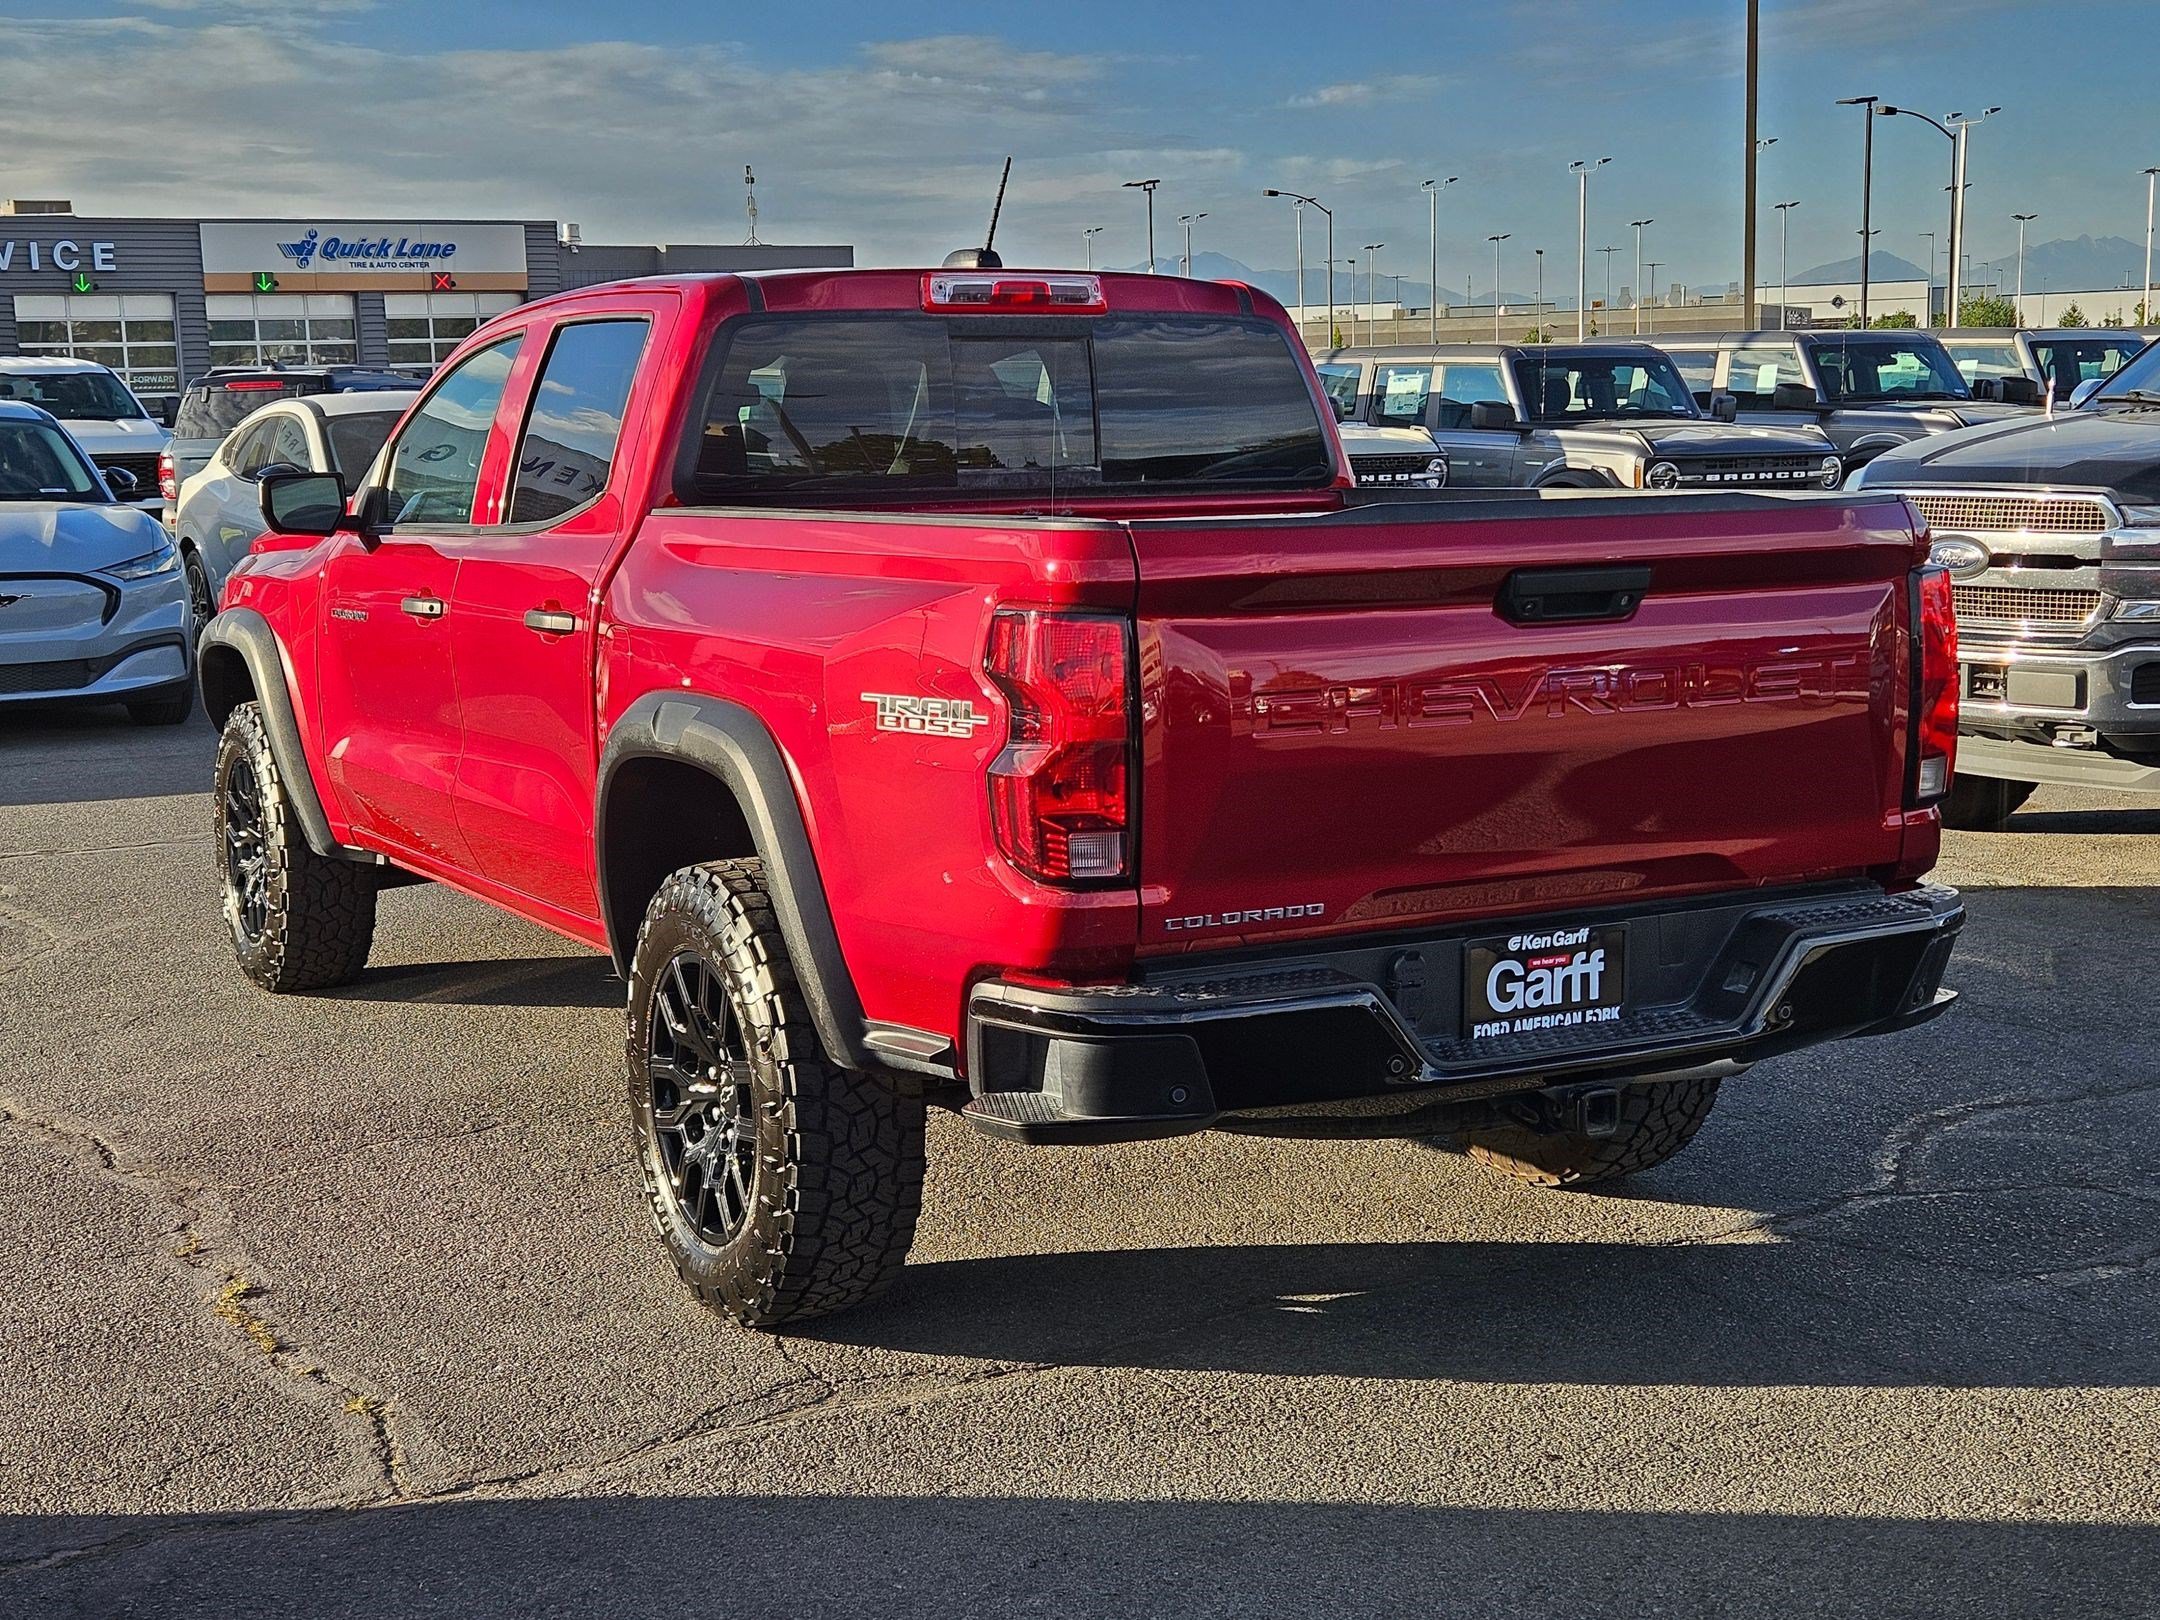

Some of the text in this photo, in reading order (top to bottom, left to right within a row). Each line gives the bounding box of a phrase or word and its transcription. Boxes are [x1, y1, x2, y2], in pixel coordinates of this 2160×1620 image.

[320, 237, 457, 261] Quick Lane
[350, 261, 430, 269] TIRE & AUTO CENTER
[133, 375, 175, 384] FORWARD
[1706, 471, 1806, 482] BRONCO
[1251, 652, 1858, 739] CHEVROLET
[861, 692, 988, 725] TRAIL
[877, 714, 973, 738] BOSS
[1165, 903, 1325, 930] COLORADO
[1522, 934, 1551, 950] Ken
[1552, 928, 1589, 947] Garff
[1486, 949, 1605, 1013] Garff
[1514, 1011, 1582, 1032] AMERICAN
